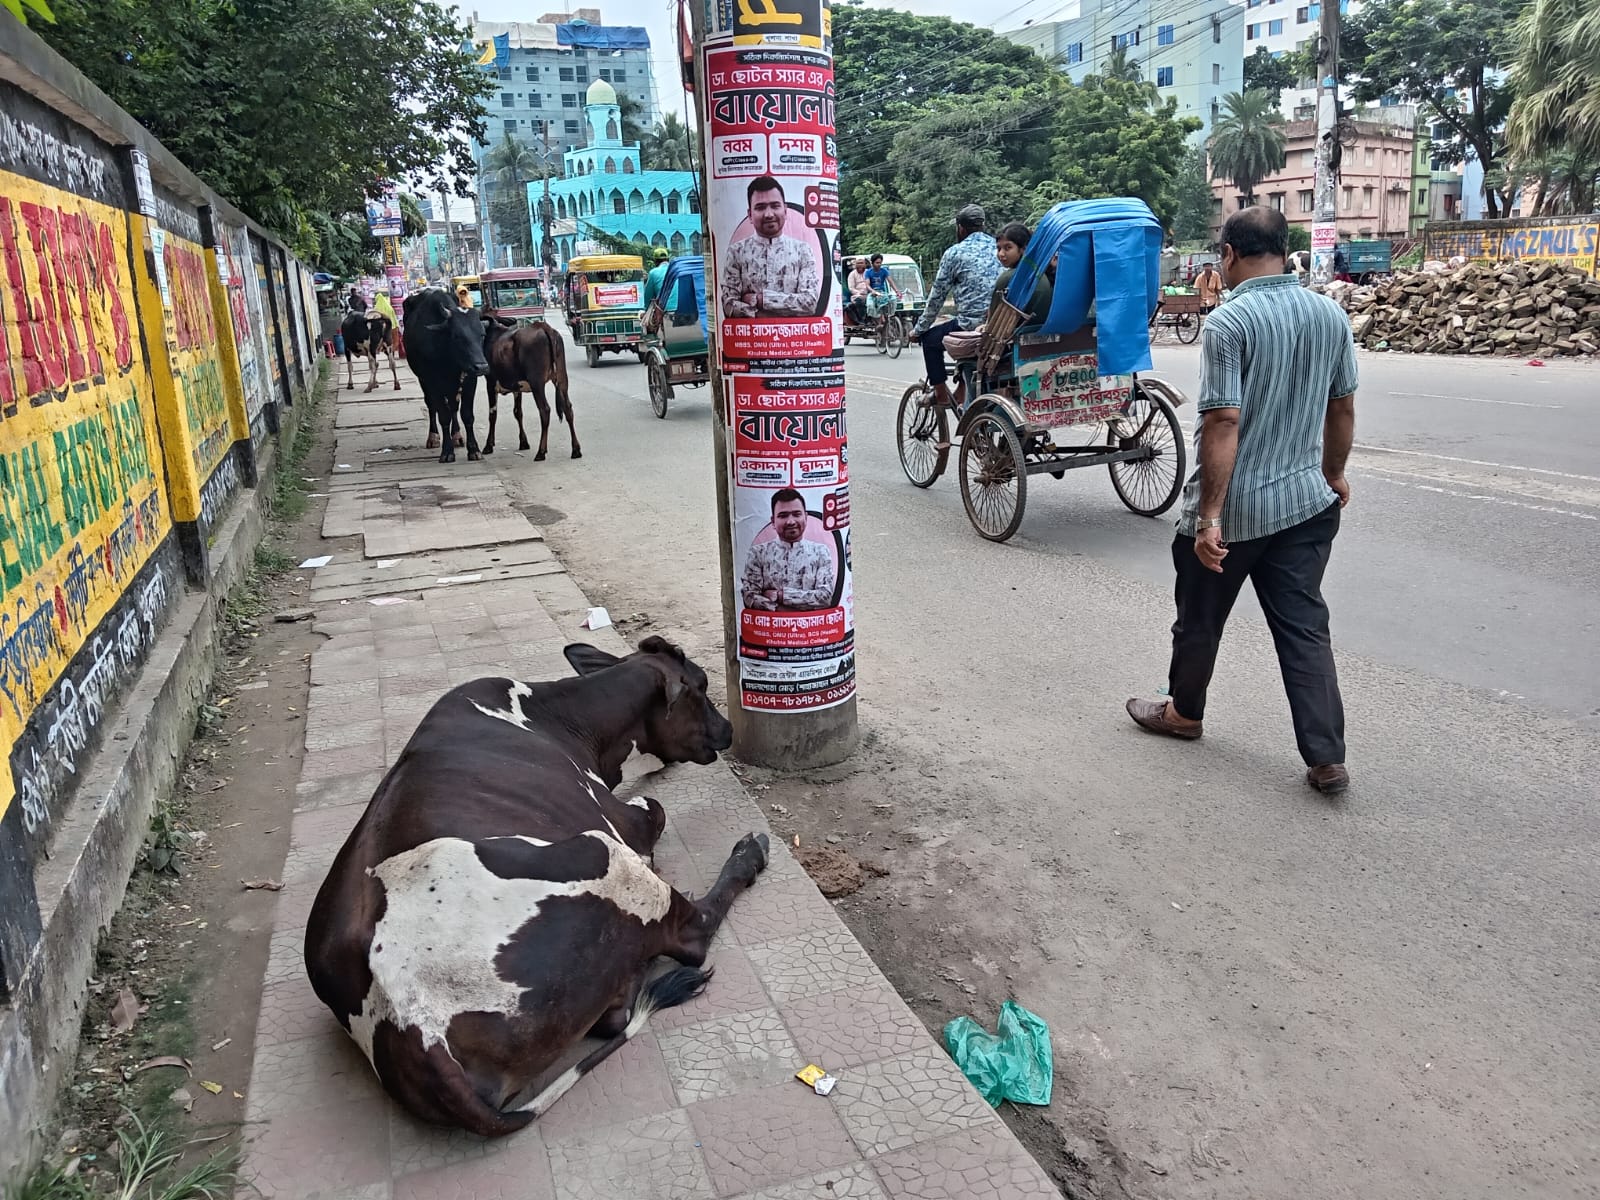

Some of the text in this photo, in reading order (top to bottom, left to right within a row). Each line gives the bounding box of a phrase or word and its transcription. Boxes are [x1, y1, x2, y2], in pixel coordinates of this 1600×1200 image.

[731, 66, 772, 84] ছোটন
[776, 69, 806, 84] স্যার
[808, 72, 823, 88] এর
[722, 138, 753, 154] নবম
[778, 138, 815, 153] দশম
[1502, 226, 1597, 258] NAZMUL'S
[810, 320, 830, 336] ছোটন
[793, 349, 815, 357] College
[757, 391, 797, 407] ছোটন
[799, 393, 826, 406] স্যার
[827, 392, 840, 404] এর
[1024, 387, 1131, 413] ইসমাইল পরিবহন
[740, 461, 788, 471] একাদশ
[799, 459, 834, 472] দ্বাদশ
[53, 413, 118, 538] BATCH
[809, 637, 829, 645] College
